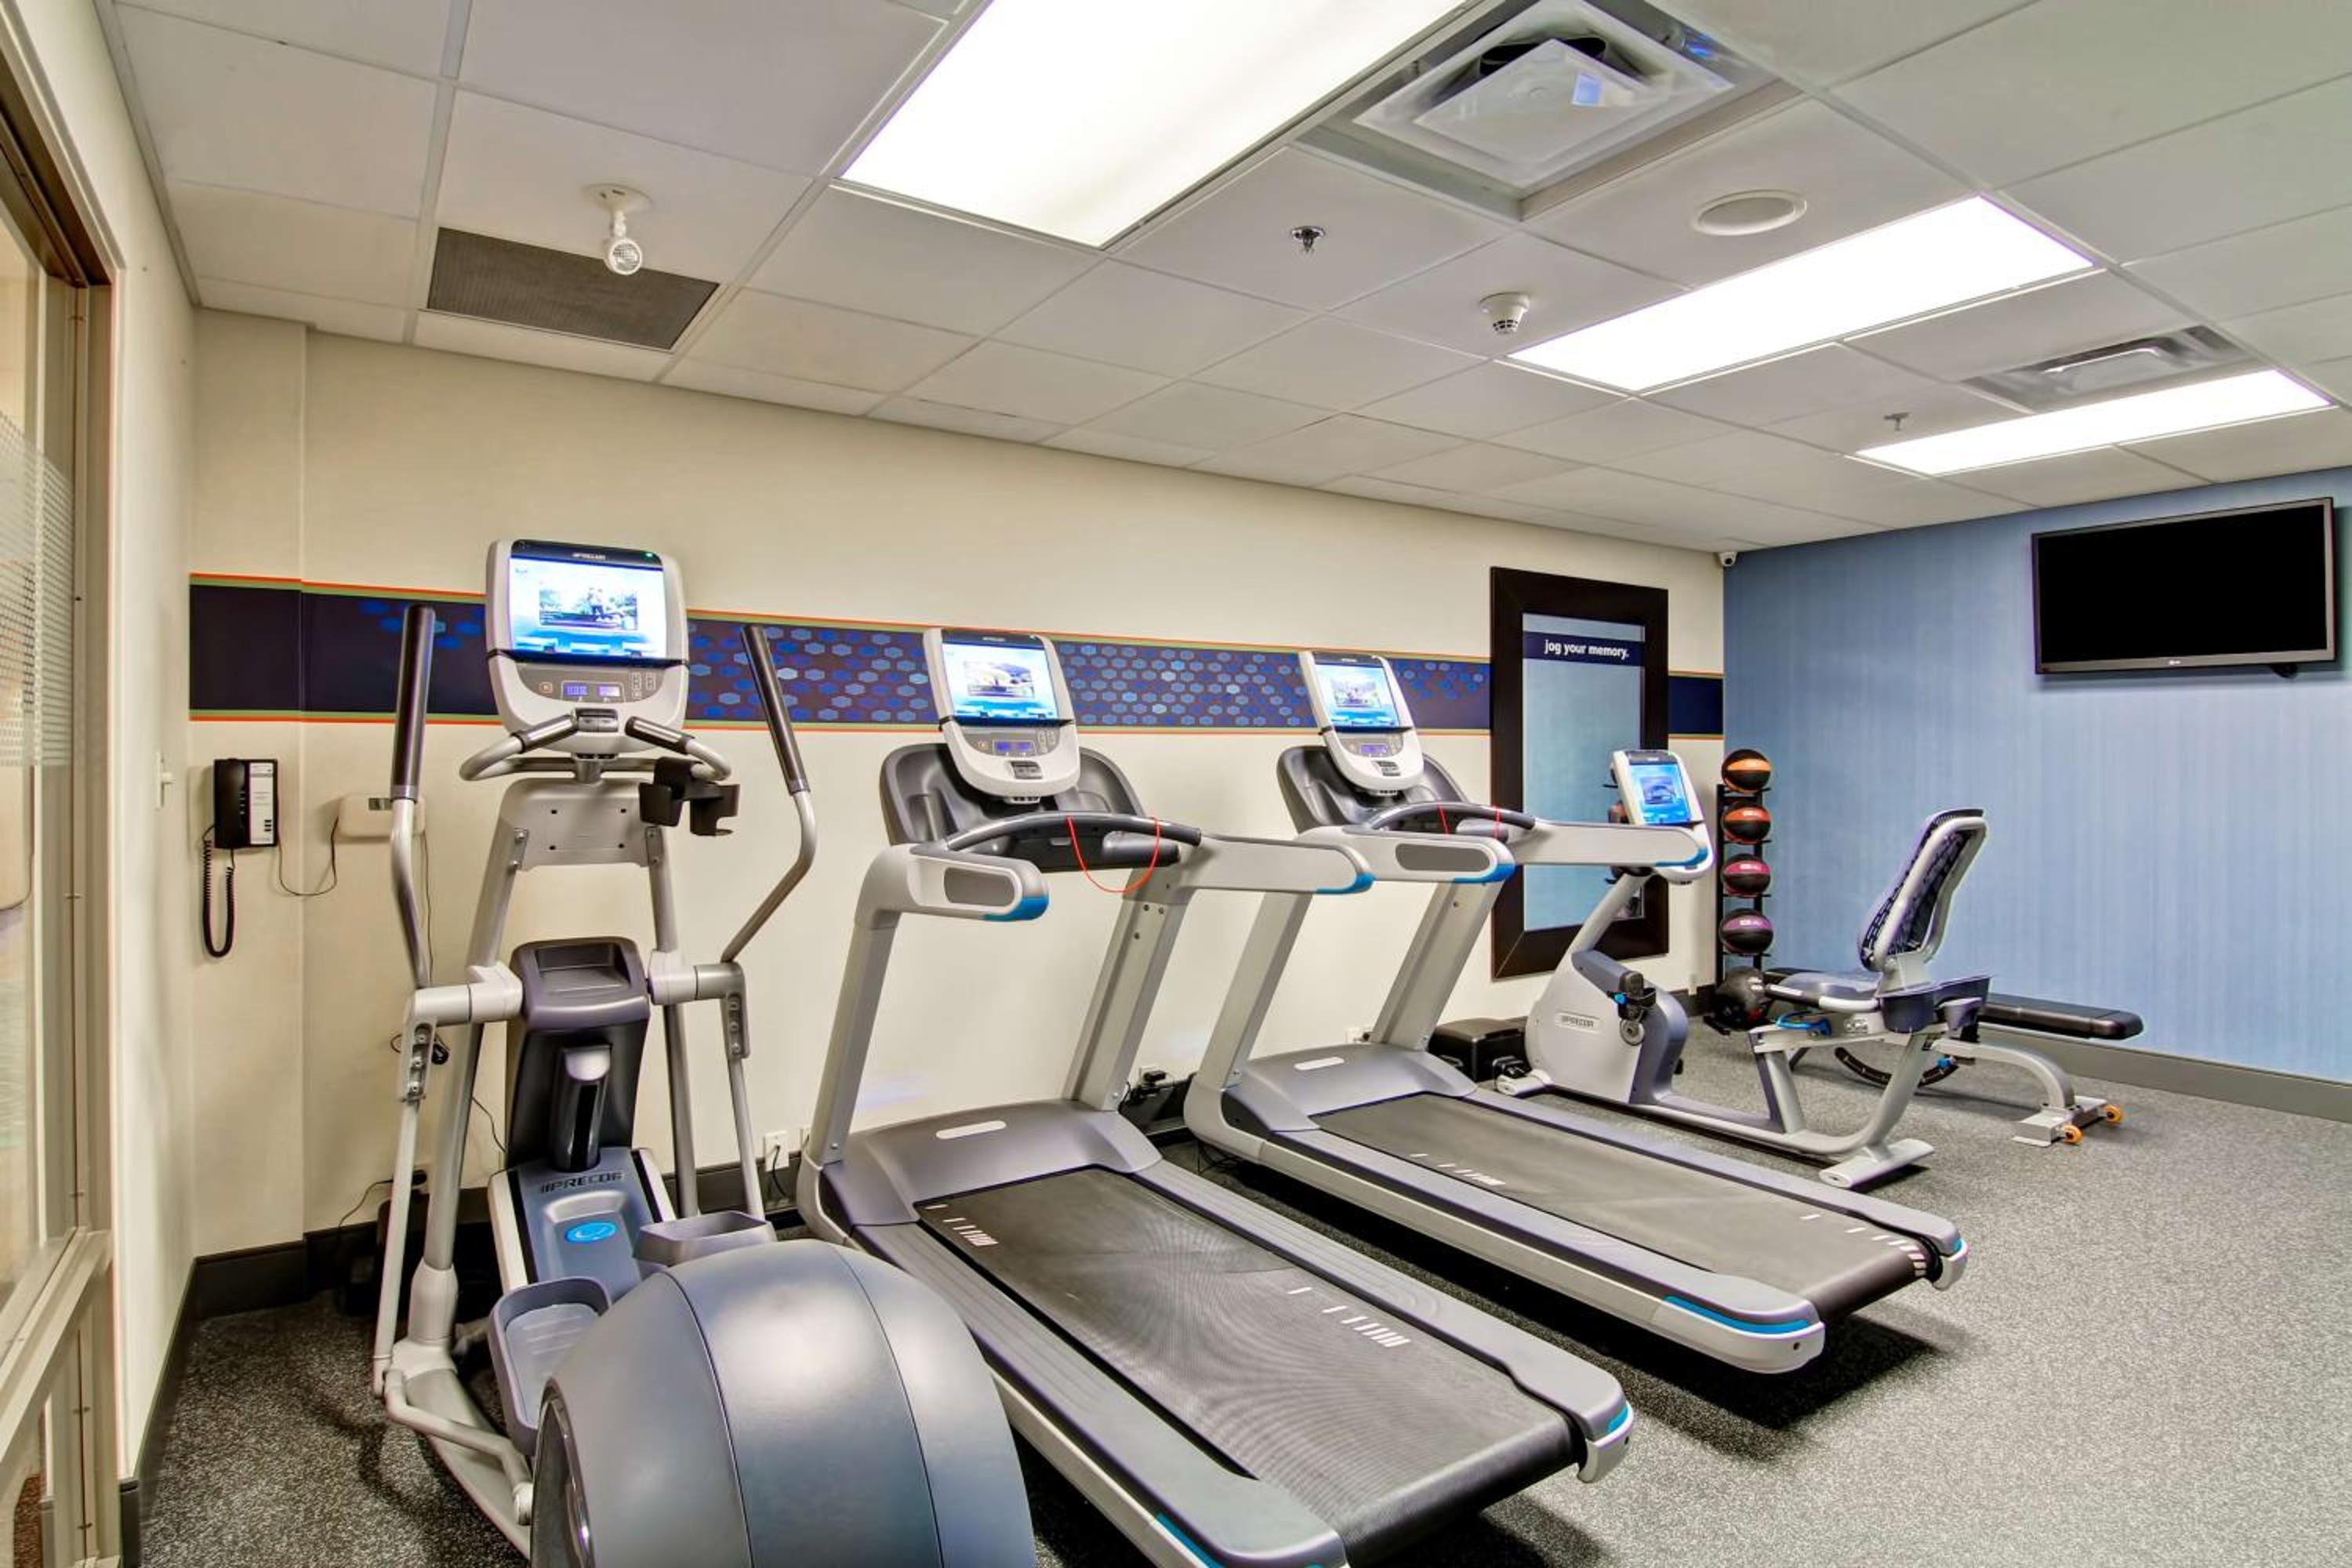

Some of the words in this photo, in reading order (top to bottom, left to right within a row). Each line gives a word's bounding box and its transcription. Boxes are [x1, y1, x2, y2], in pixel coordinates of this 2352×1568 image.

[1544, 639, 1562, 655] jog
[1563, 644, 1587, 655] your
[1588, 645, 1630, 660] memory.
